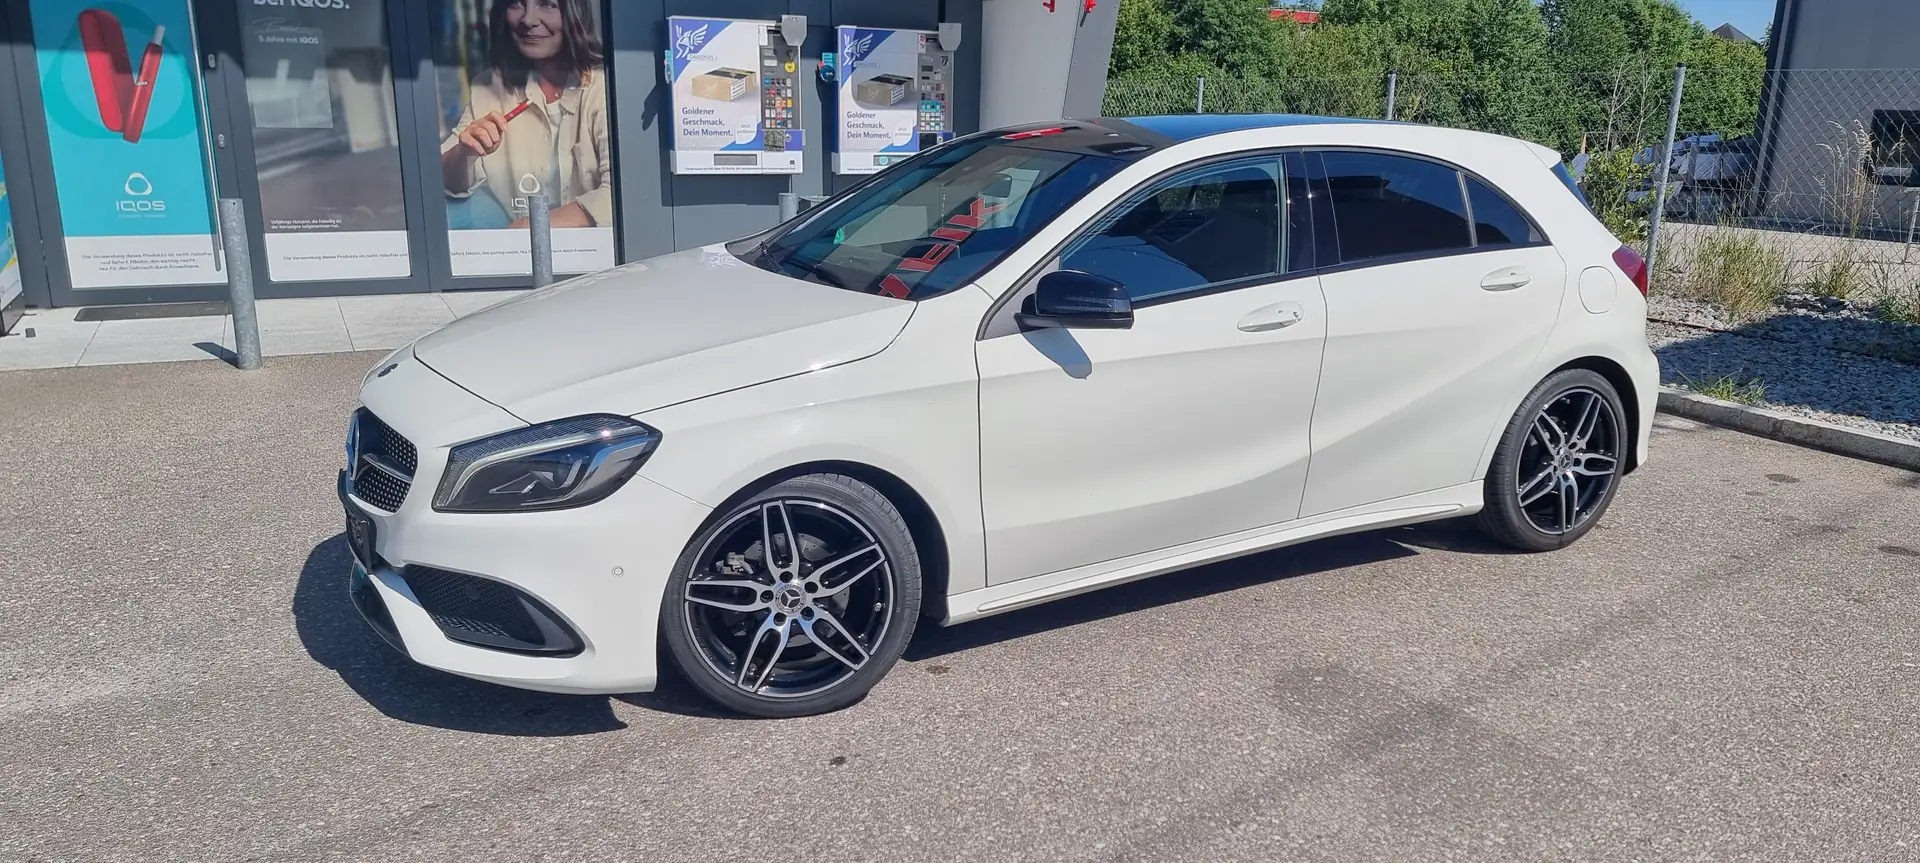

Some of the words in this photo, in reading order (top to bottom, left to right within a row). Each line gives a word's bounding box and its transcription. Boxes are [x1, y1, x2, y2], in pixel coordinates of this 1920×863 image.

[265, 35, 285, 43] Jahre
[299, 36, 319, 44] IQOS
[682, 107, 715, 115] Goldener
[682, 118, 726, 126] Geschmack,
[846, 122, 885, 130] Geschmack,
[701, 128, 734, 136] Moment.
[115, 200, 166, 212] IQOS
[511, 197, 529, 208] IQ
